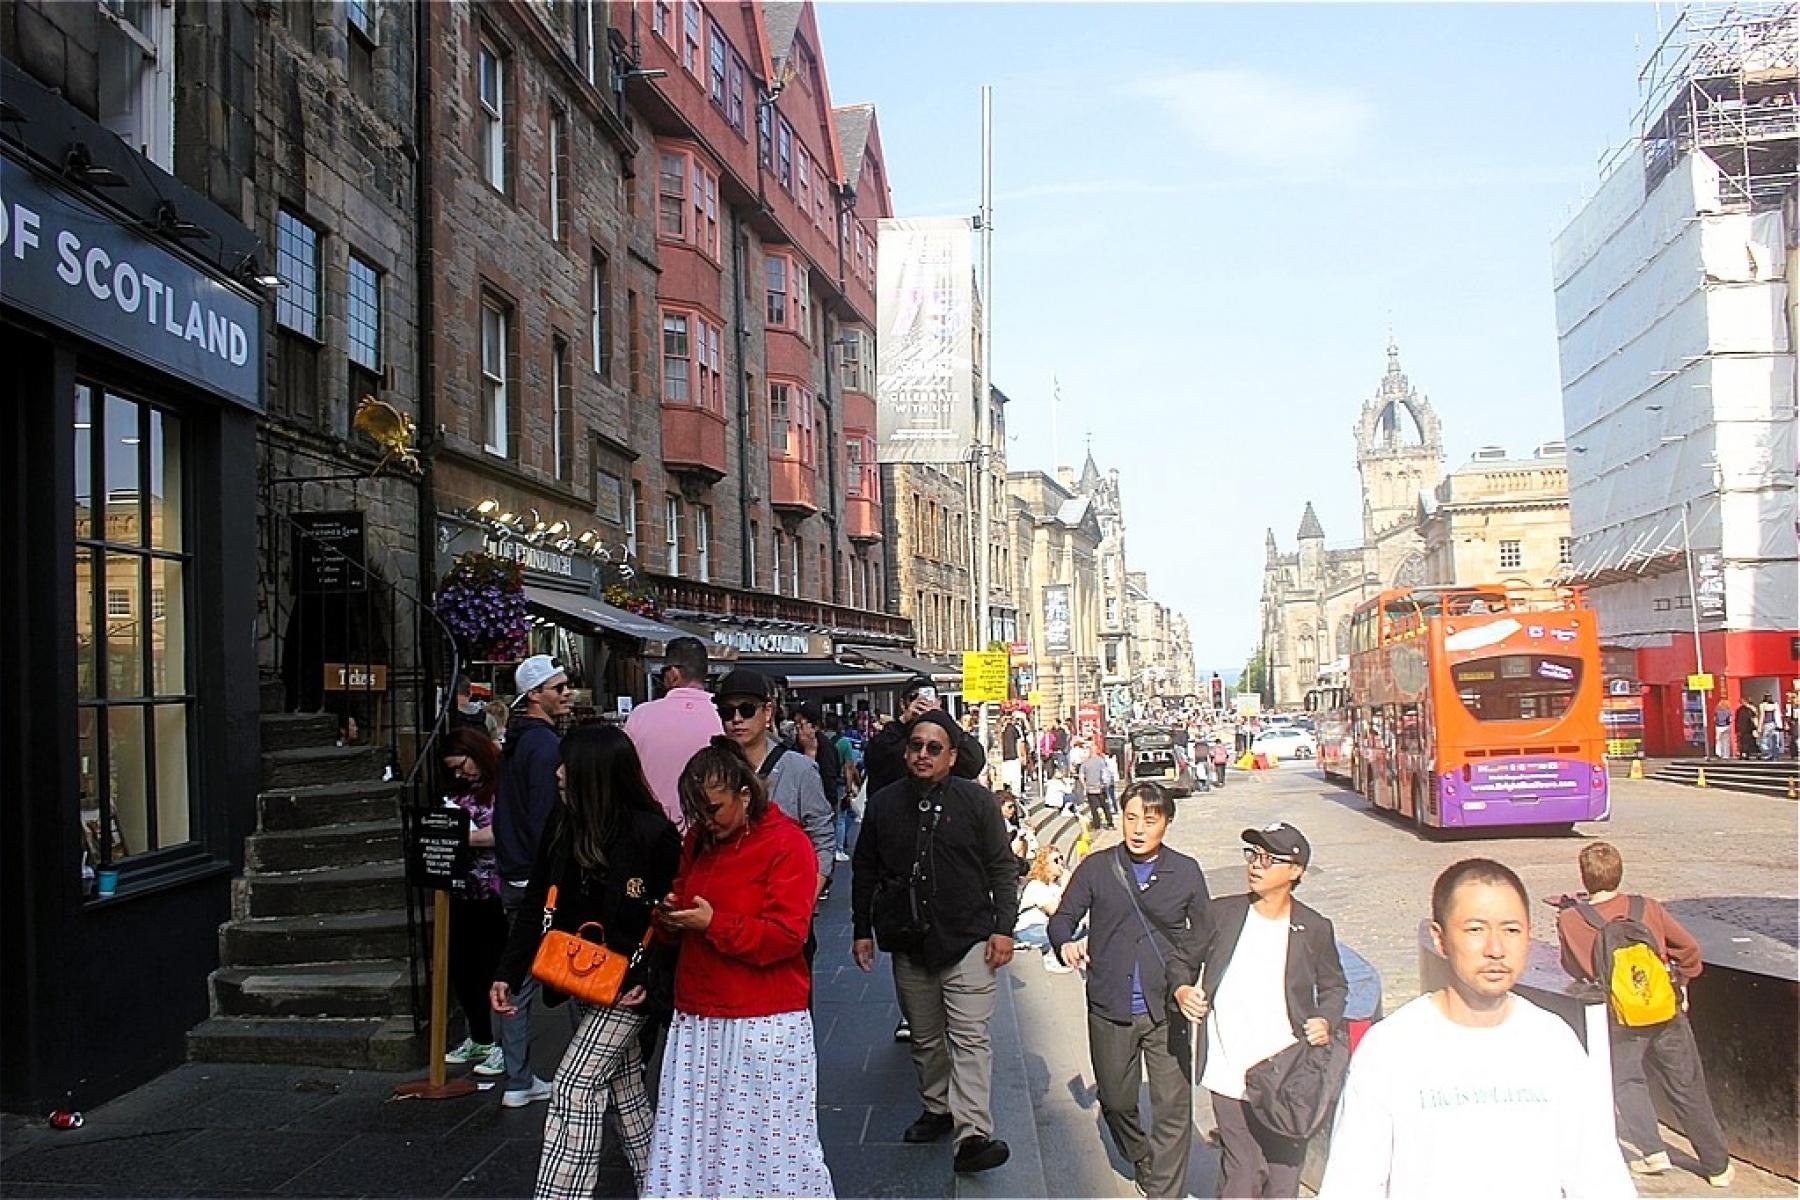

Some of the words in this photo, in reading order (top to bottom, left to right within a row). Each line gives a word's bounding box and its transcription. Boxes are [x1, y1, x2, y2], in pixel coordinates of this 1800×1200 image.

[56, 229, 249, 368] SCOTLAND
[890, 391, 961, 402] CELEBRATE
[895, 403, 928, 413] WITH
